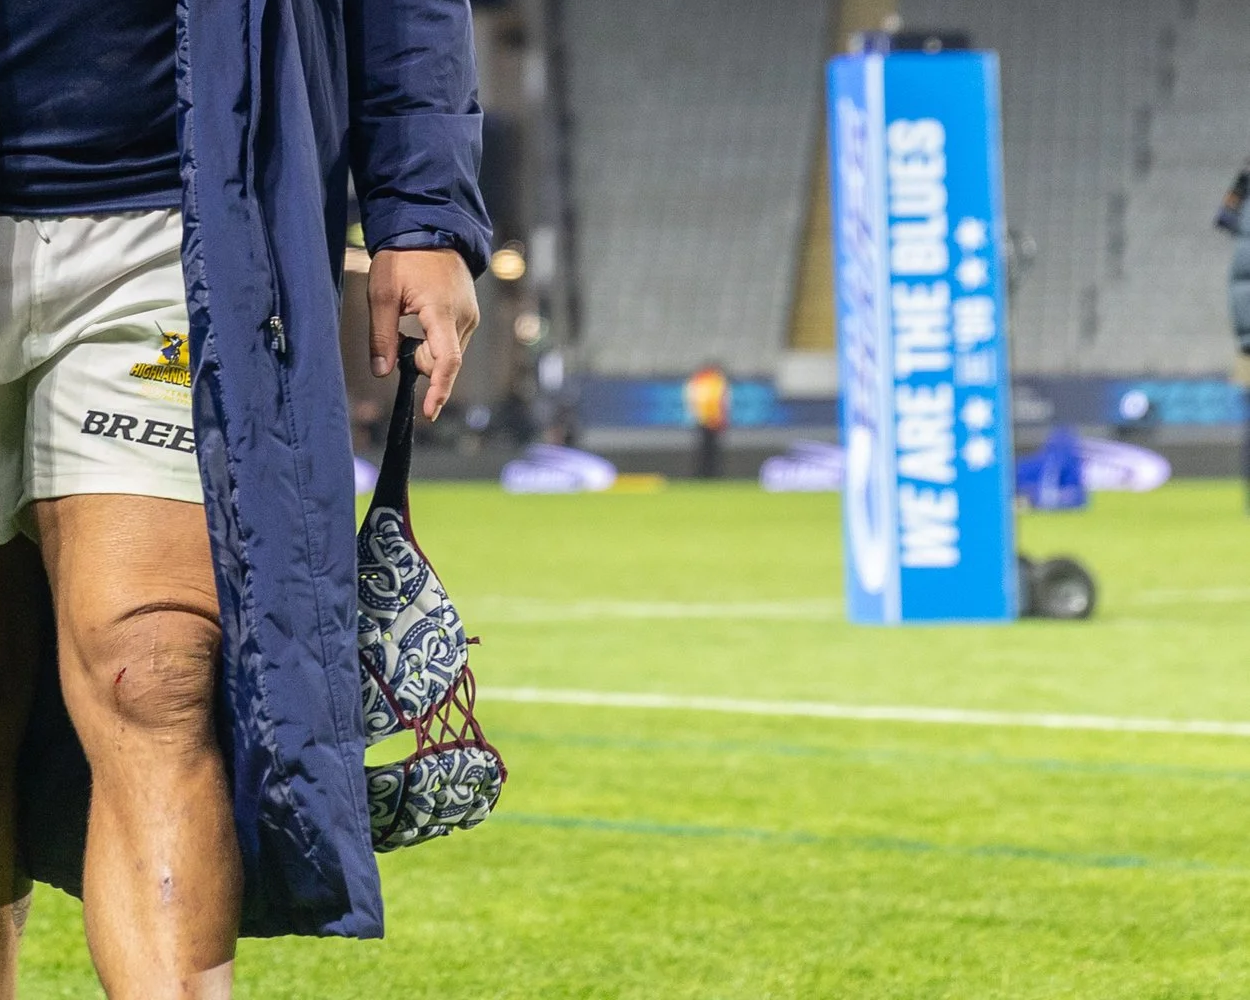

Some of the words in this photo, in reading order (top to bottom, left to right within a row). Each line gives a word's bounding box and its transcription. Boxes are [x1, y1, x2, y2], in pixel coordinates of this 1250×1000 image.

[888, 118, 949, 275] BLUES
[893, 281, 951, 378] THE
[897, 383, 956, 484] ARE
[900, 486, 960, 567] WE
